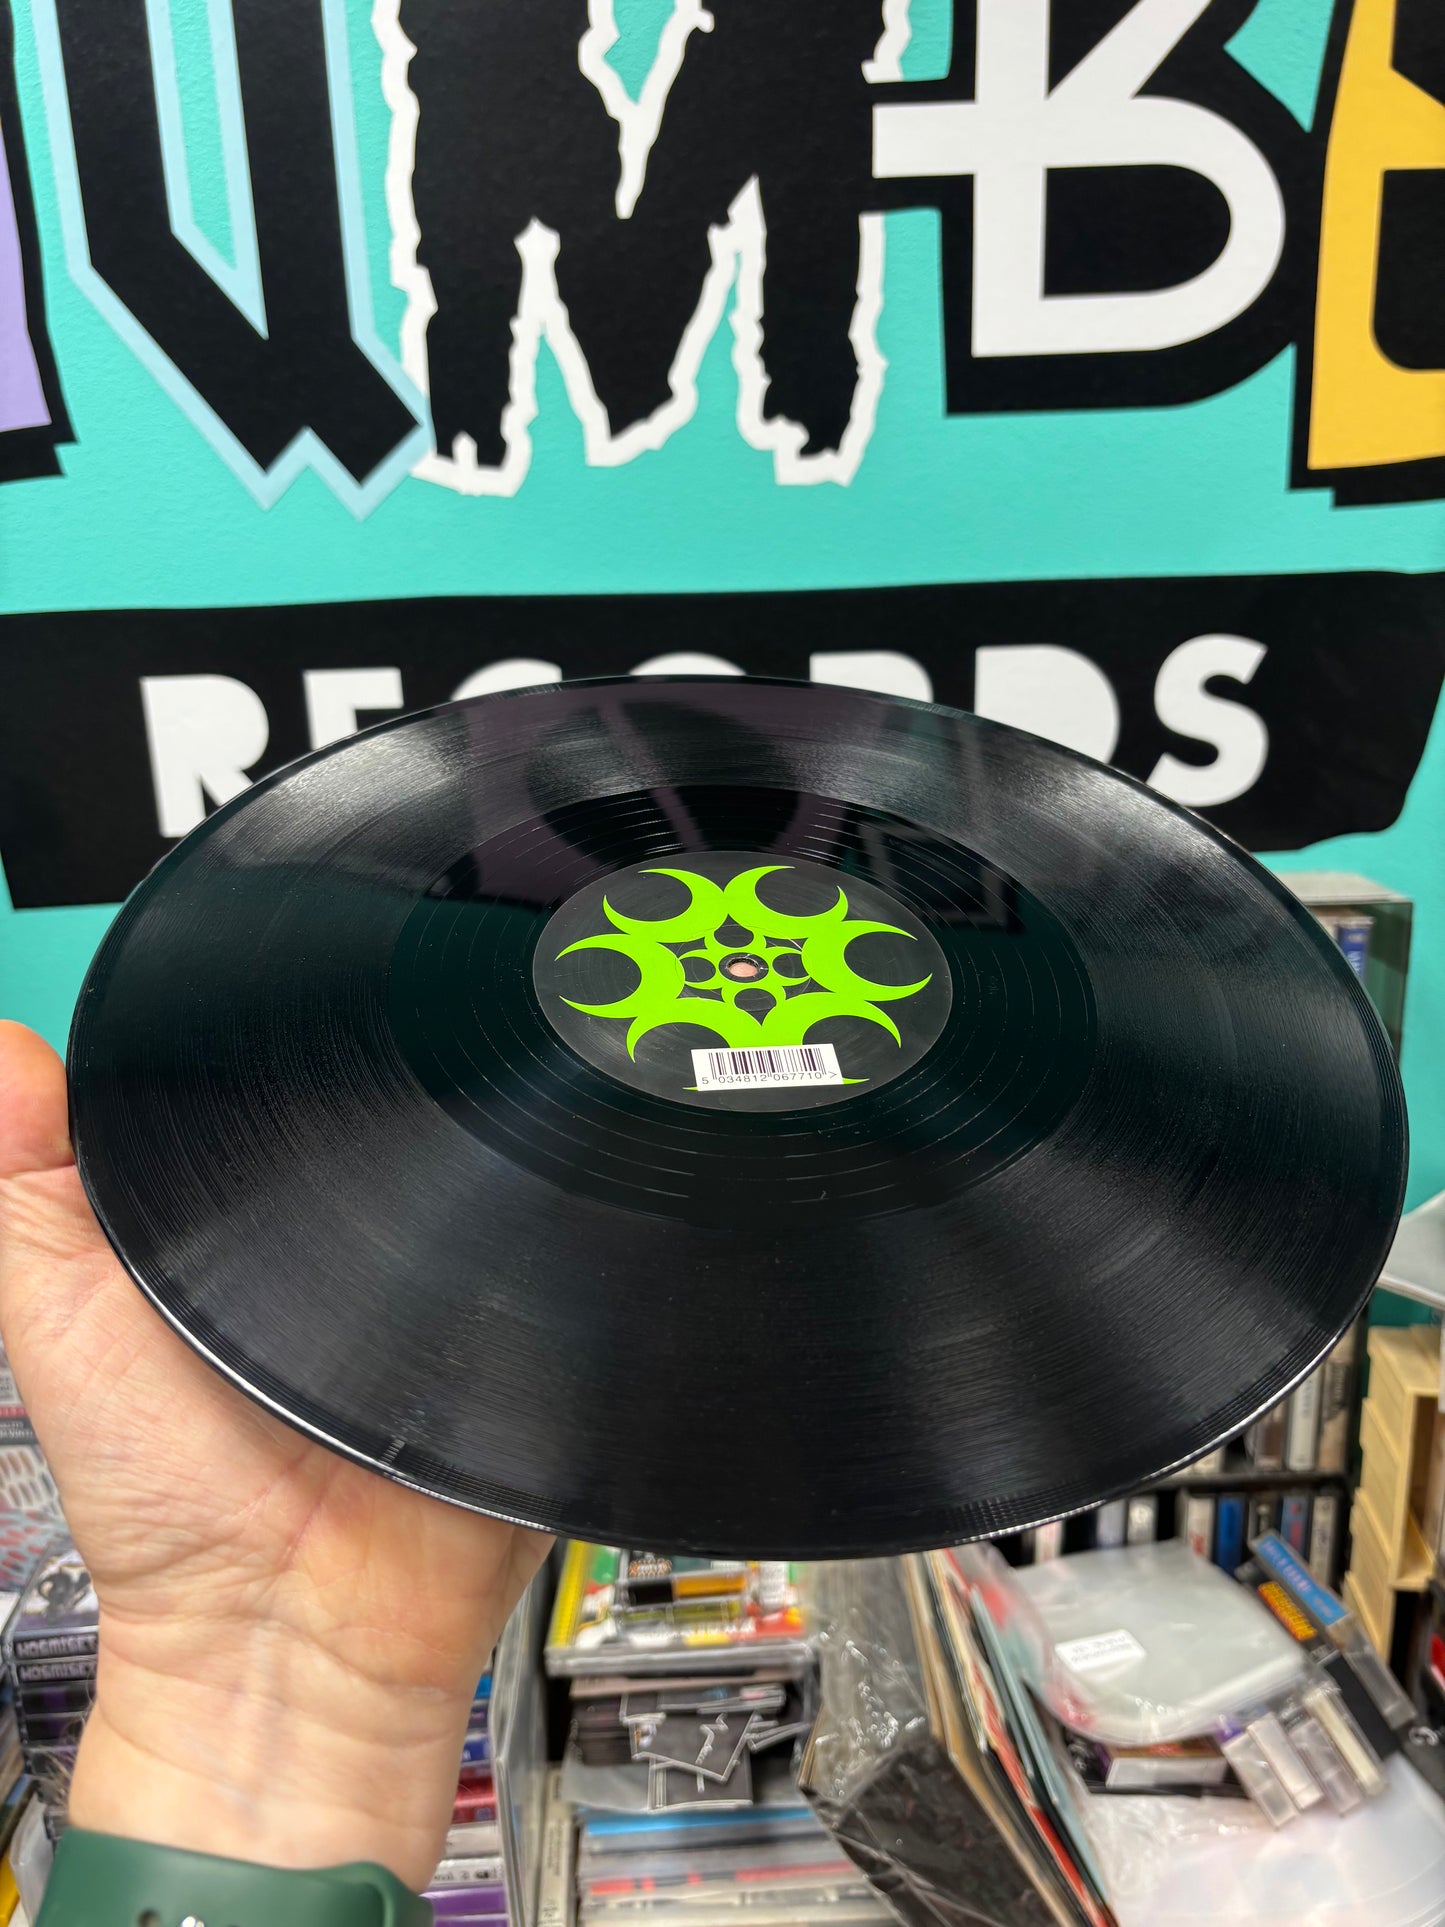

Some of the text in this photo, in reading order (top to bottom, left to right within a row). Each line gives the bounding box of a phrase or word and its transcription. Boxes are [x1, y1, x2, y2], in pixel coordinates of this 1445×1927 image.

[701, 1077, 710, 1085] 5
[718, 1074, 768, 1084] 034812
[773, 1072, 822, 1082] 067710
